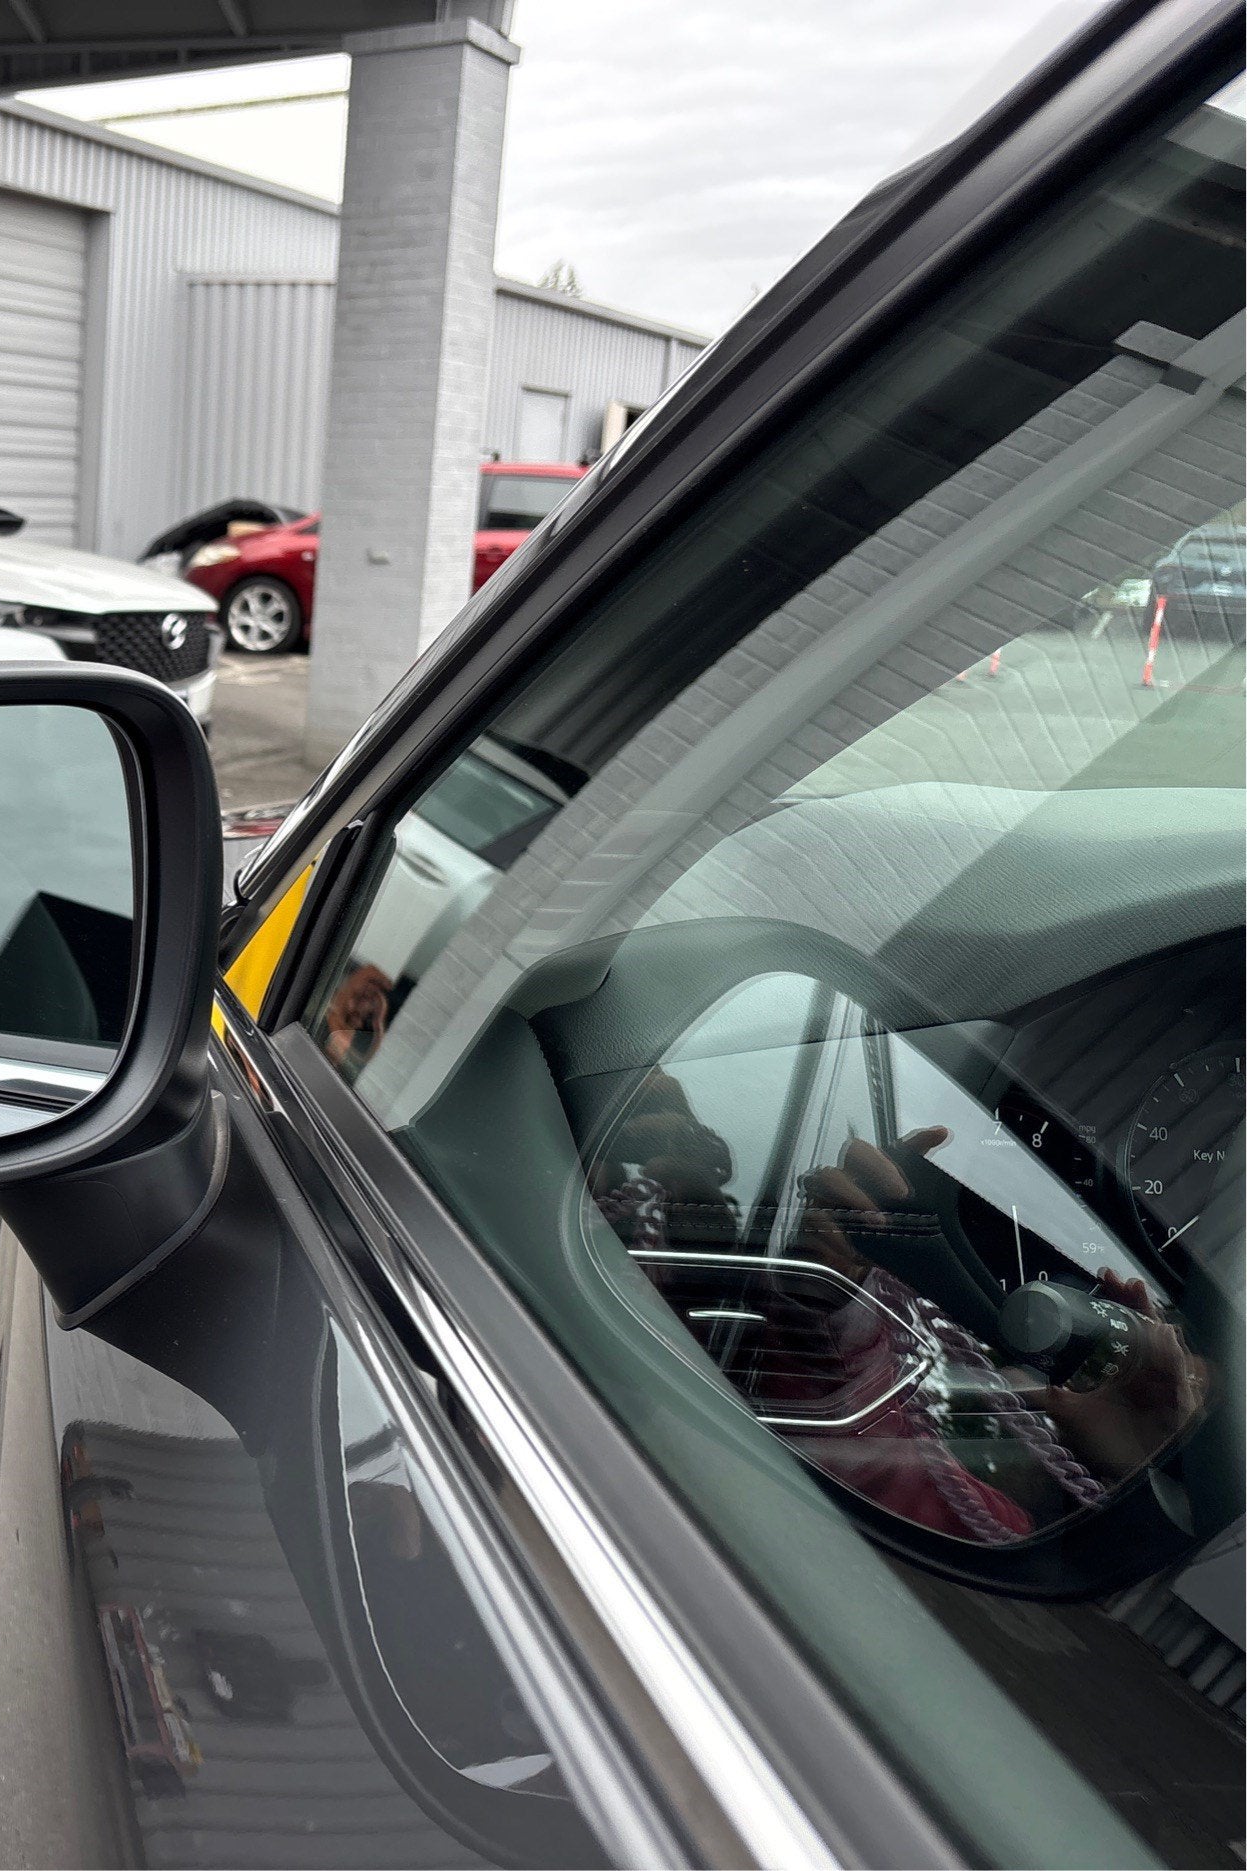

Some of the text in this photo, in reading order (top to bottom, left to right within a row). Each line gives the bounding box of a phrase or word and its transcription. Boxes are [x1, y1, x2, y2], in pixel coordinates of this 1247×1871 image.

[992, 1121, 1002, 1136] 7
[1078, 1125, 1096, 1134] mpg
[1149, 1127, 1168, 1142] 40
[1032, 1133, 1042, 1148] 8
[1193, 1149, 1214, 1164] Key
[1083, 1179, 1094, 1187] 40
[1144, 1180, 1163, 1195] 20
[1109, 1318, 1129, 1332] AUTO
